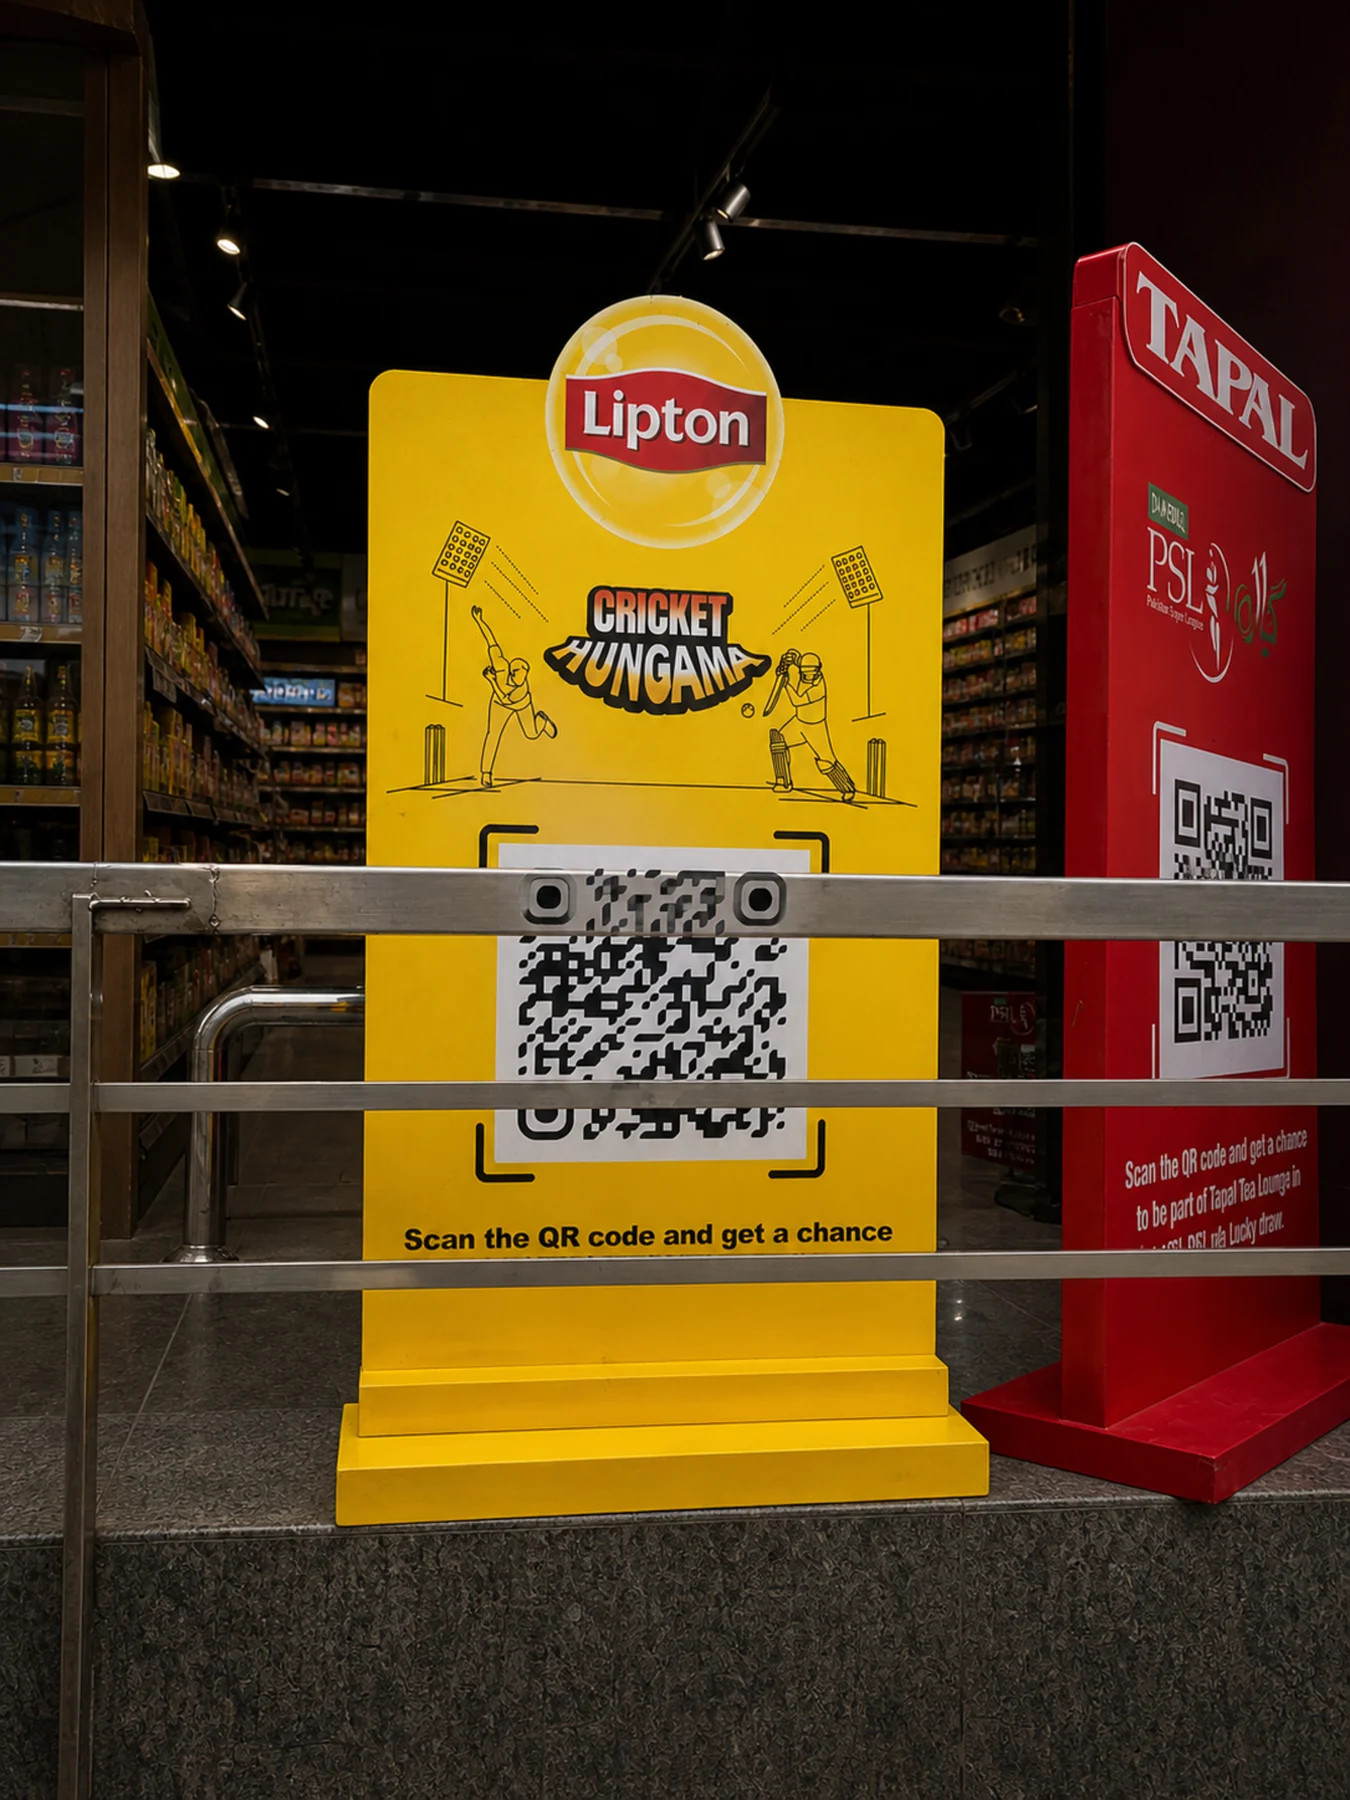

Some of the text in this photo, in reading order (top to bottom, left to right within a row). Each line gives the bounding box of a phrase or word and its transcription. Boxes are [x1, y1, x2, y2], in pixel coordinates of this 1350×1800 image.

[1136, 271, 1308, 470] TAPAL
[583, 389, 749, 451] Lipton
[1147, 527, 1204, 614] PSL
[592, 588, 729, 639] CRICKET
[551, 638, 764, 706] HUNGAMA
[1125, 1129, 1307, 1189] Scan the QR code and get a chance
[1136, 1165, 1301, 1231] to be part of Tapal Tea Lounge in
[1229, 1217, 1256, 1245] Lucky
[1259, 1212, 1284, 1236] draw.
[404, 1222, 893, 1250] Scan the QR code and get a chance
